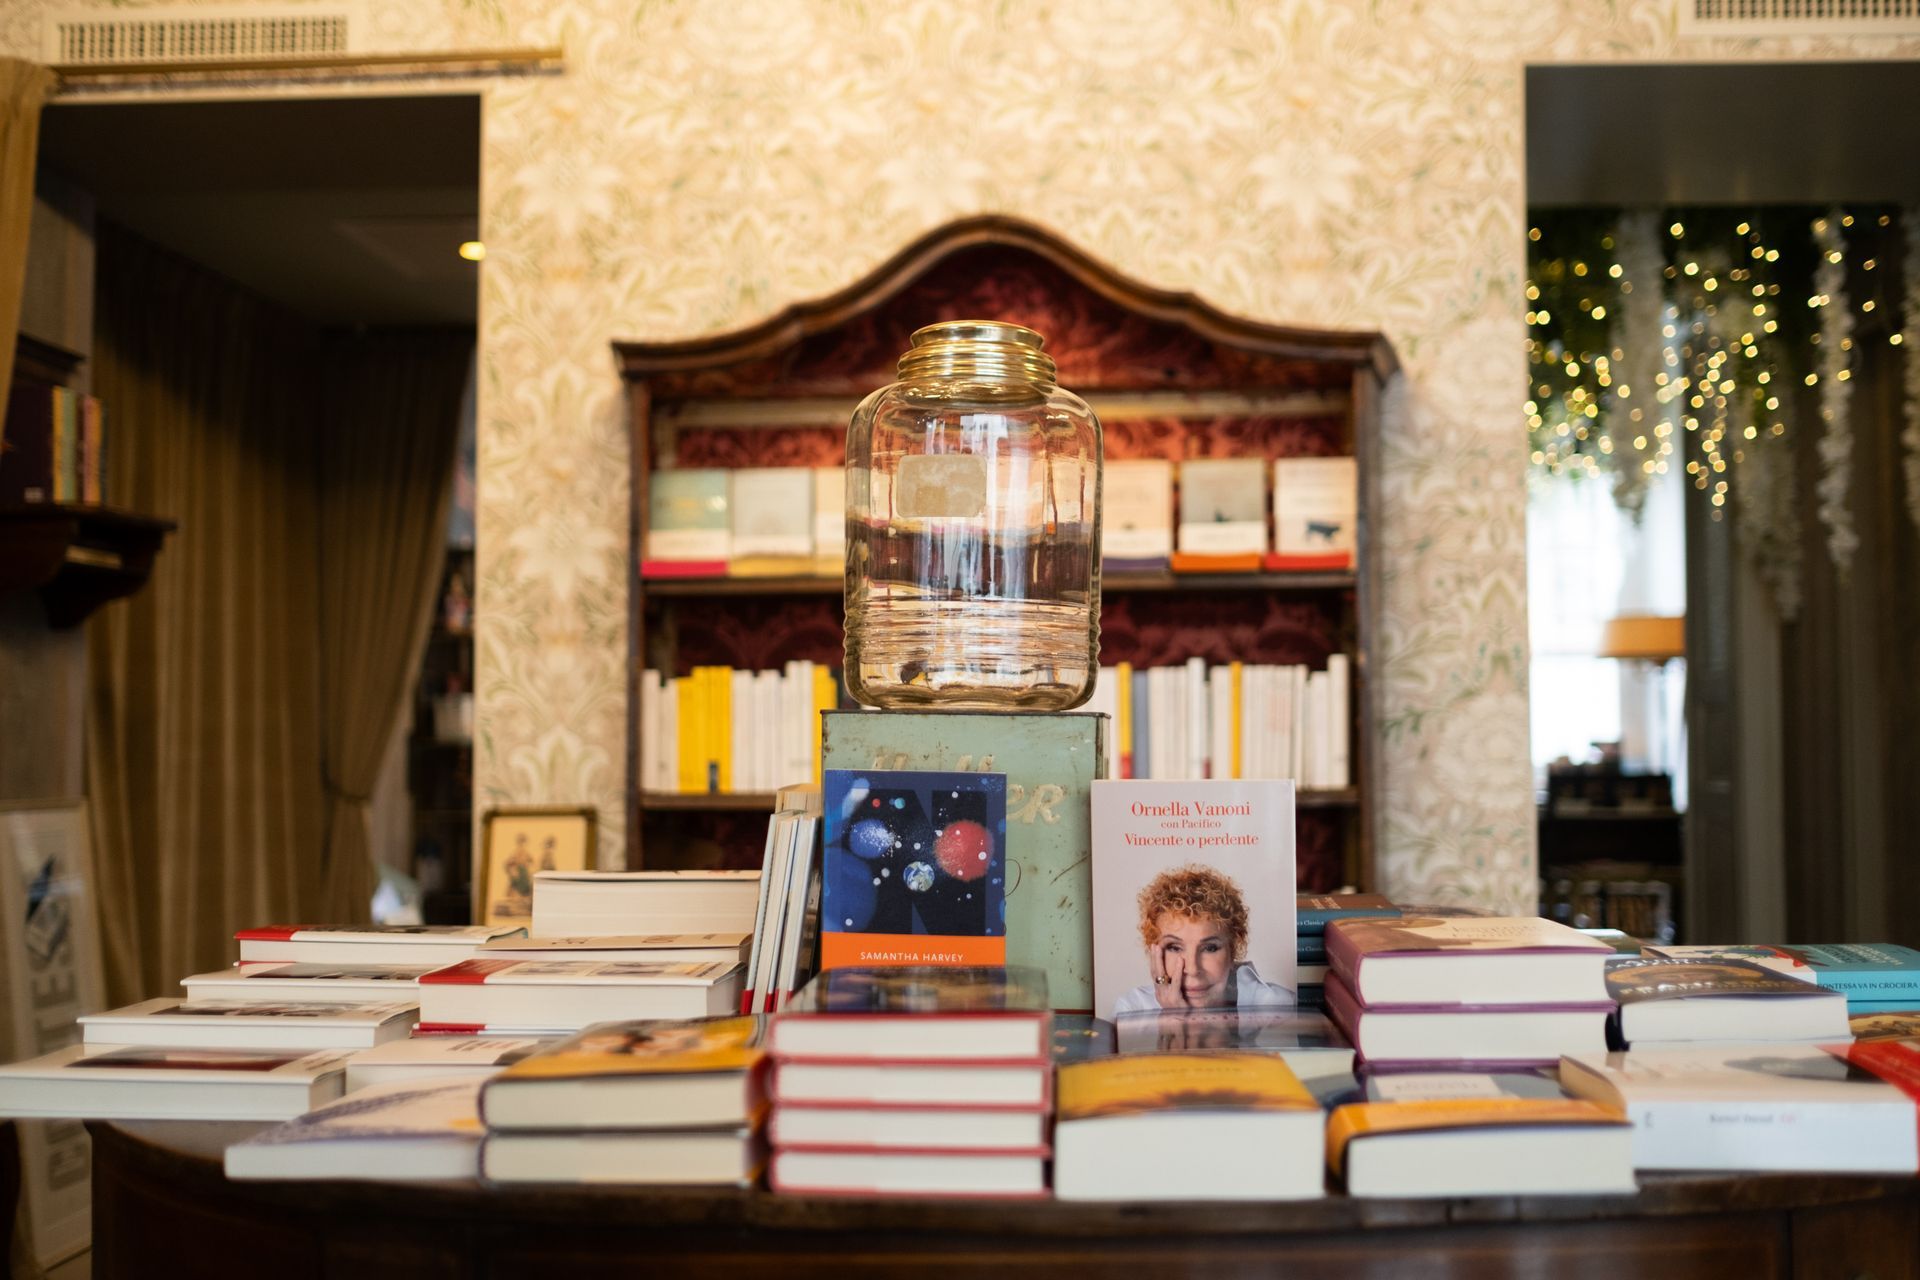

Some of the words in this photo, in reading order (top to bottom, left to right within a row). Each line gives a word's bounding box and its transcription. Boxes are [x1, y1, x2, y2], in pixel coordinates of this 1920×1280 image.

[1131, 801, 1189, 816] Ornella
[1193, 801, 1251, 816] Vanoni
[1160, 820, 1179, 829] con
[1182, 819, 1222, 829] Pacifico
[1124, 833, 1183, 846] Vincente
[1186, 836, 1195, 846] o
[1198, 833, 1259, 848] perdente
[860, 951, 919, 961] SAMANTHA
[922, 953, 964, 962] HARVEY
[1878, 981, 1919, 990] CROCIERA
